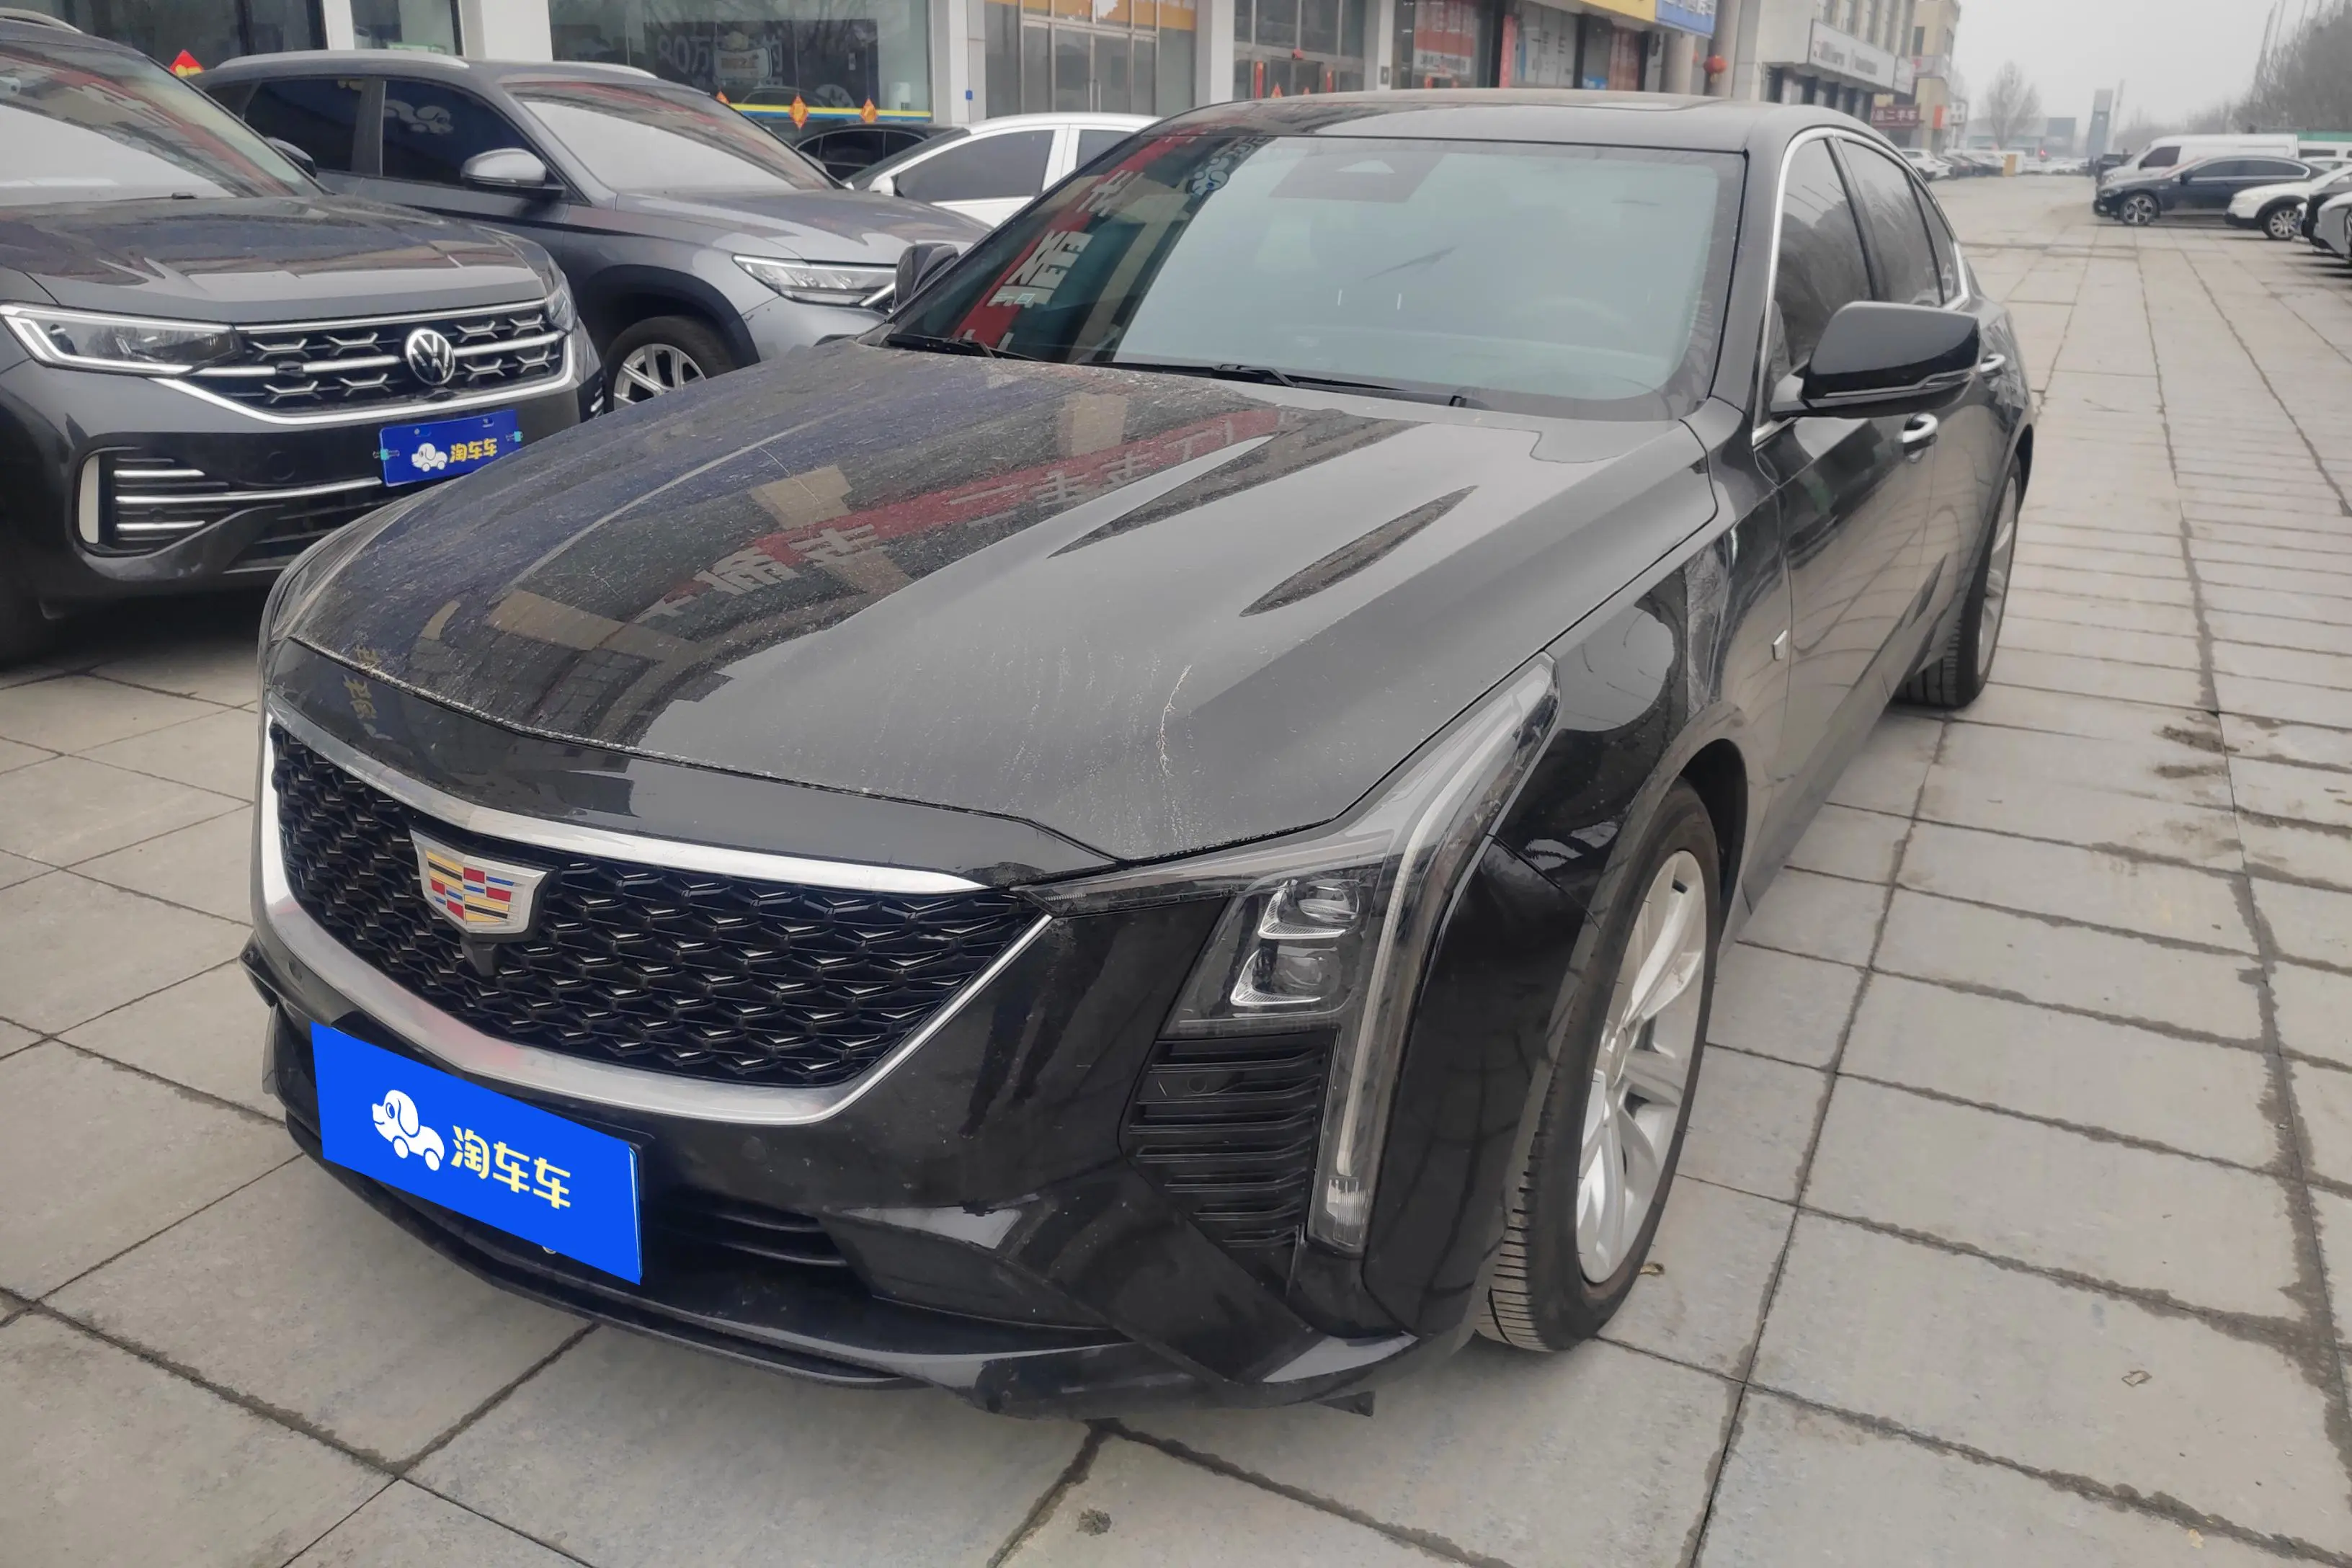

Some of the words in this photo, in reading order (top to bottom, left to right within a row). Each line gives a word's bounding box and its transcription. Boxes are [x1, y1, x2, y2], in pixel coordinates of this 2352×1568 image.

[450, 438, 497, 463] 淘车车
[450, 1125, 571, 1210] 淘车车
